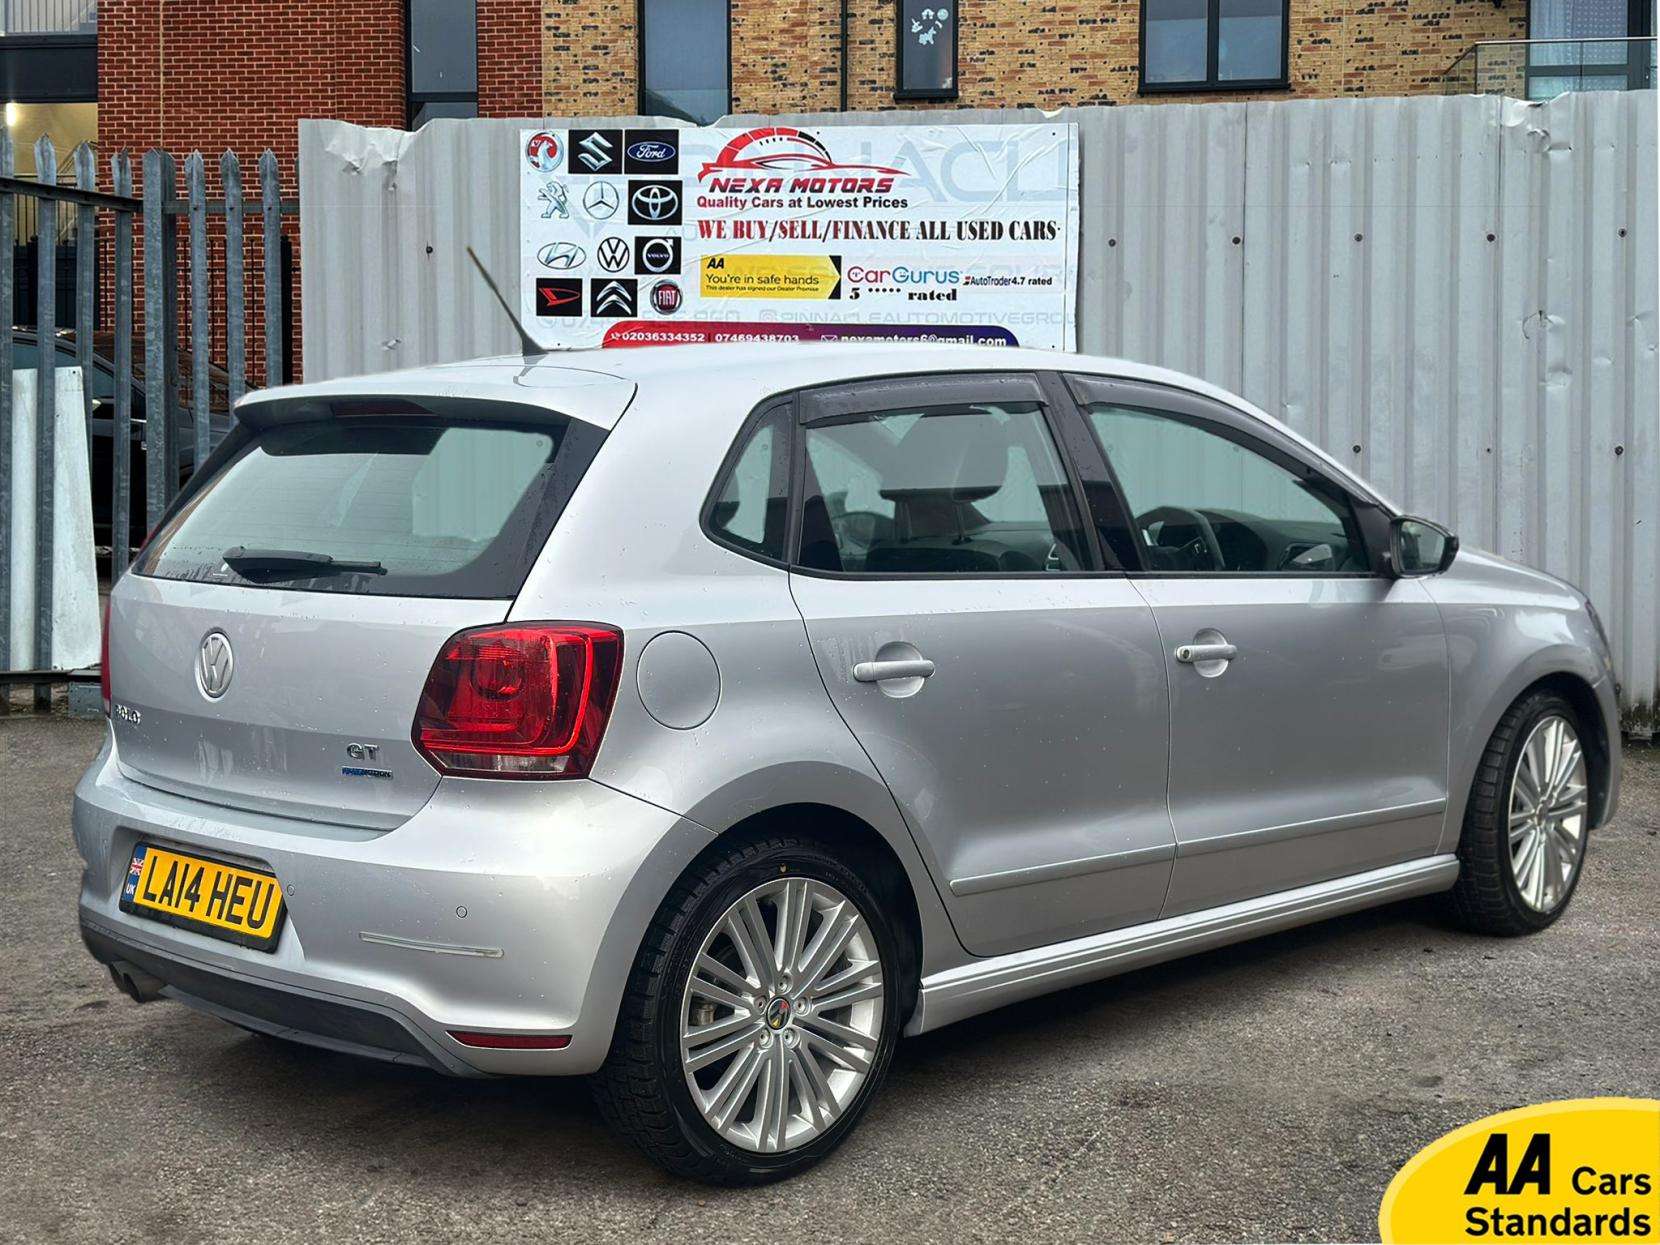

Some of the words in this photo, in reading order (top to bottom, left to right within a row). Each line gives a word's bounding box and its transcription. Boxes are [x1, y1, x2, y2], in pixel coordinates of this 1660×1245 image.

[637, 144, 666, 158] Ford
[709, 177, 783, 193] NEXA
[789, 177, 895, 193] MOTORS
[697, 196, 747, 211] Quality
[752, 196, 784, 208] Cars
[788, 197, 802, 208] at
[807, 196, 858, 208] Lowest
[863, 196, 908, 208] Prices
[698, 220, 727, 240] WE
[733, 220, 911, 243] BUY/SELL/FINANCE
[916, 220, 951, 240] ALL
[957, 220, 1004, 240] USED
[1009, 220, 1057, 240] CARS
[707, 257, 725, 269] AA
[706, 274, 741, 284] You're
[744, 274, 754, 284] in
[757, 274, 781, 285] safe
[784, 274, 820, 285] hands
[847, 266, 960, 283] CarGurus
[1028, 277, 1052, 285] rated
[658, 290, 676, 305] FIAT
[849, 287, 860, 300] 5
[908, 288, 957, 301] rated
[622, 332, 705, 342] 02036334352
[714, 333, 800, 343] 07469438703
[346, 742, 380, 760] GT
[125, 883, 135, 895] UK
[142, 855, 205, 912] LA14
[205, 871, 275, 929] HEU
